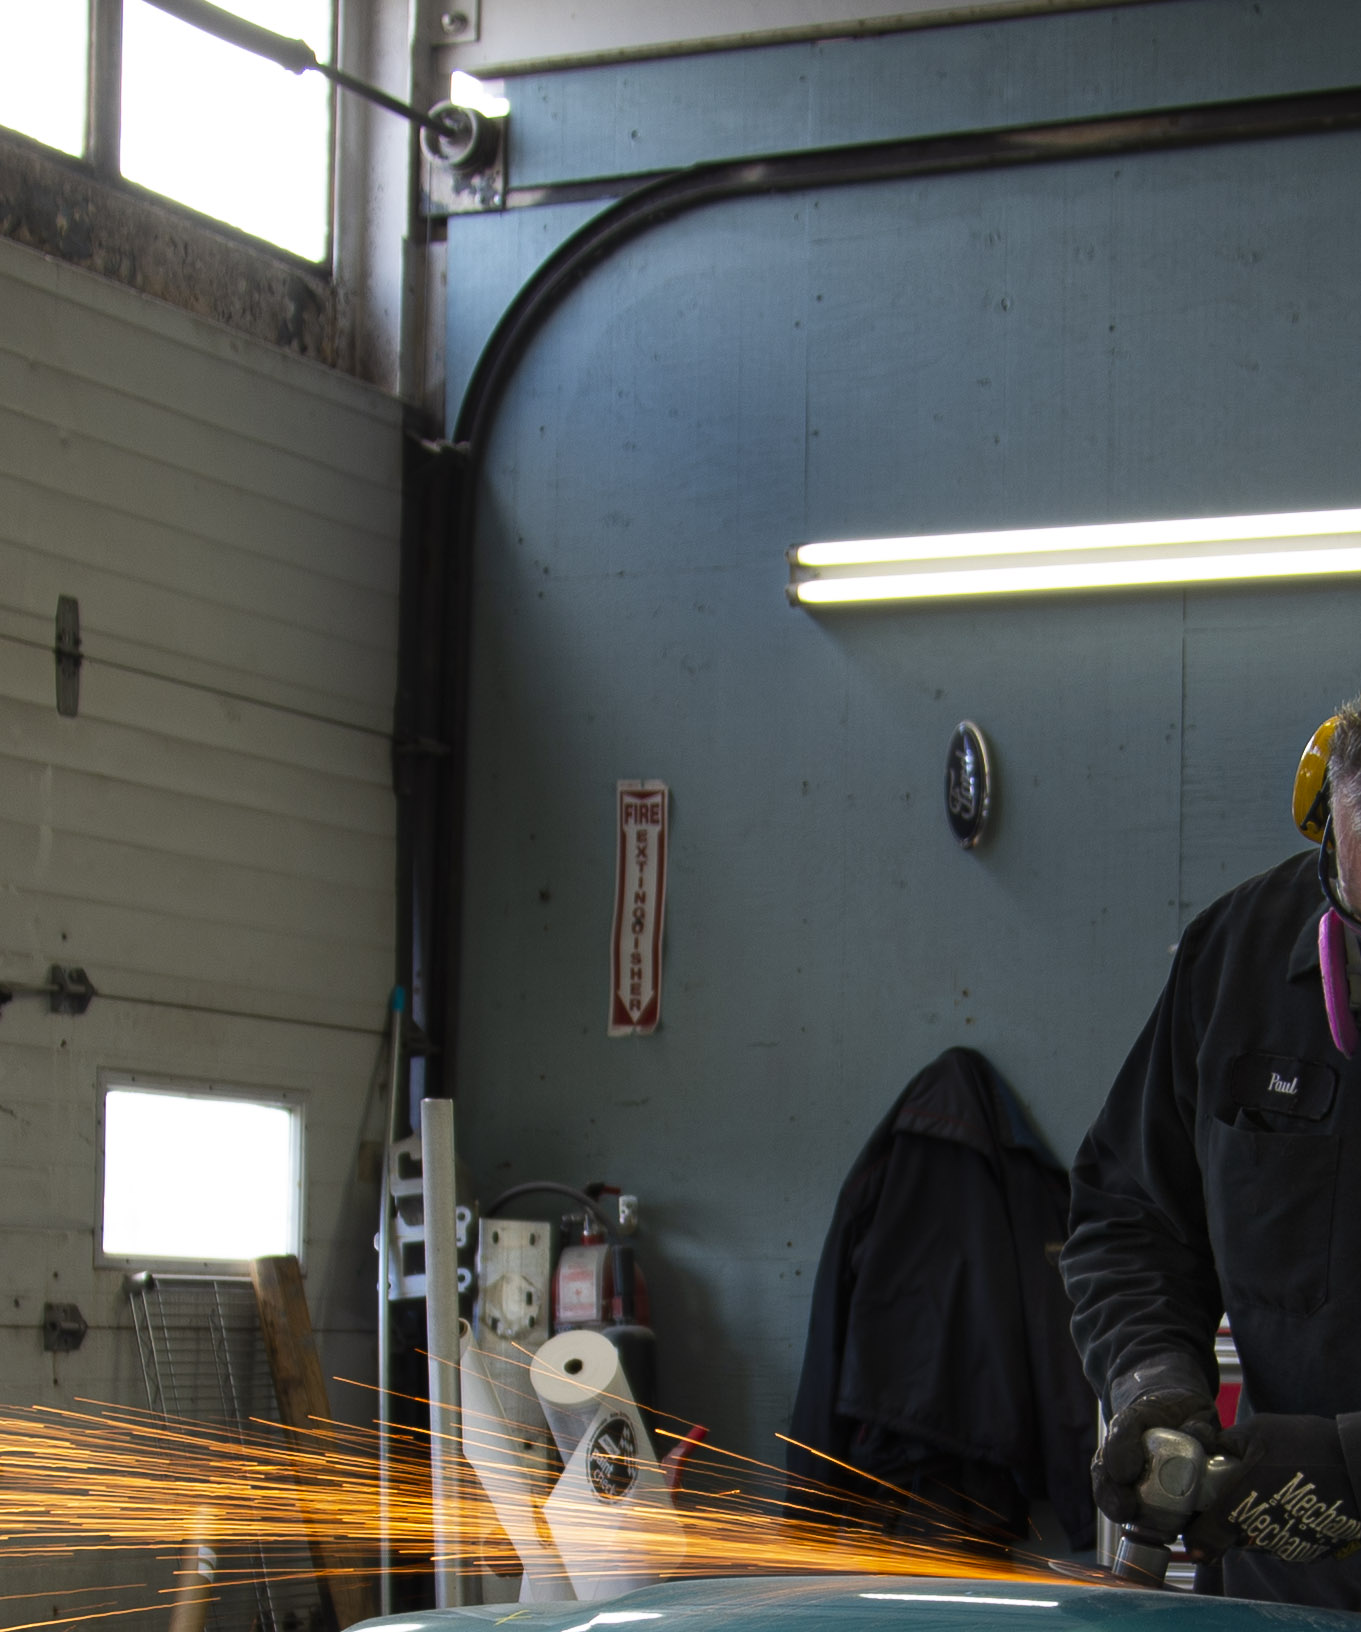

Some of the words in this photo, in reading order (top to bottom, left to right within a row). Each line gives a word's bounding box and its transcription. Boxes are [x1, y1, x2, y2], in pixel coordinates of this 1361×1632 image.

[950, 750, 975, 820] Ford
[624, 801, 661, 826] FIRE
[629, 829, 648, 1011] EXTINGUISHER
[1268, 1072, 1298, 1094] Paul
